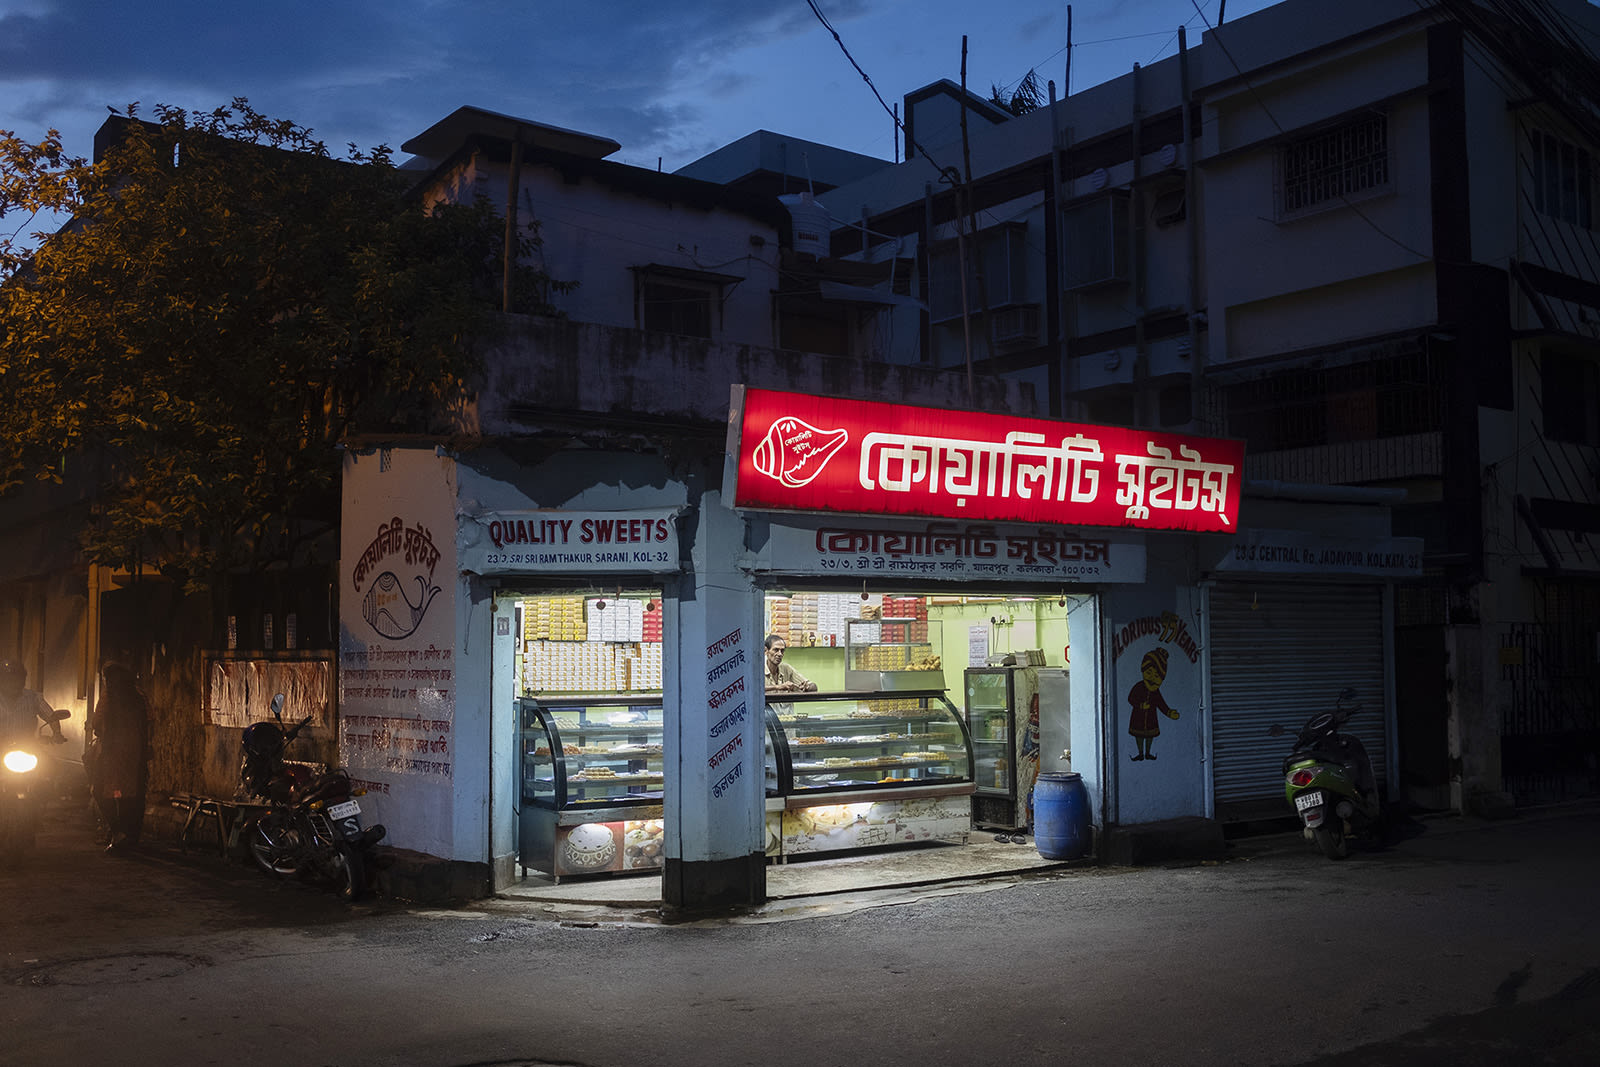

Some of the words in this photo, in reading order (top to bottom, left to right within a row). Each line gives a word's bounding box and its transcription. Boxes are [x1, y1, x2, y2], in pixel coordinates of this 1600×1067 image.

[859, 432, 1104, 506] কোয়ালিটি
[1116, 440, 1234, 525] সুইটস্
[489, 519, 573, 549] QUALITY
[580, 518, 668, 543] SWEETS
[815, 523, 996, 558] কোয়ালিটি
[1007, 530, 1111, 568] সুইটস্
[353, 516, 402, 592] কোয়ালিটি
[487, 554, 508, 564] 23/3,
[509, 554, 524, 564] SRI
[525, 554, 538, 564] SRI
[595, 552, 632, 564] SARANI,
[633, 552, 668, 562] KOL-32
[857, 556, 870, 569] শ্রী
[872, 556, 886, 569] শ্রী
[888, 558, 936, 571] রামঠাকুর
[1259, 546, 1300, 563] CENTRAL
[1367, 552, 1419, 569] KOLKATA-32
[706, 628, 742, 659] রসগোল্লা
[1174, 620, 1200, 664] YEARS
[706, 649, 746, 684] রসমালাই
[712, 762, 743, 799] জলভরা
